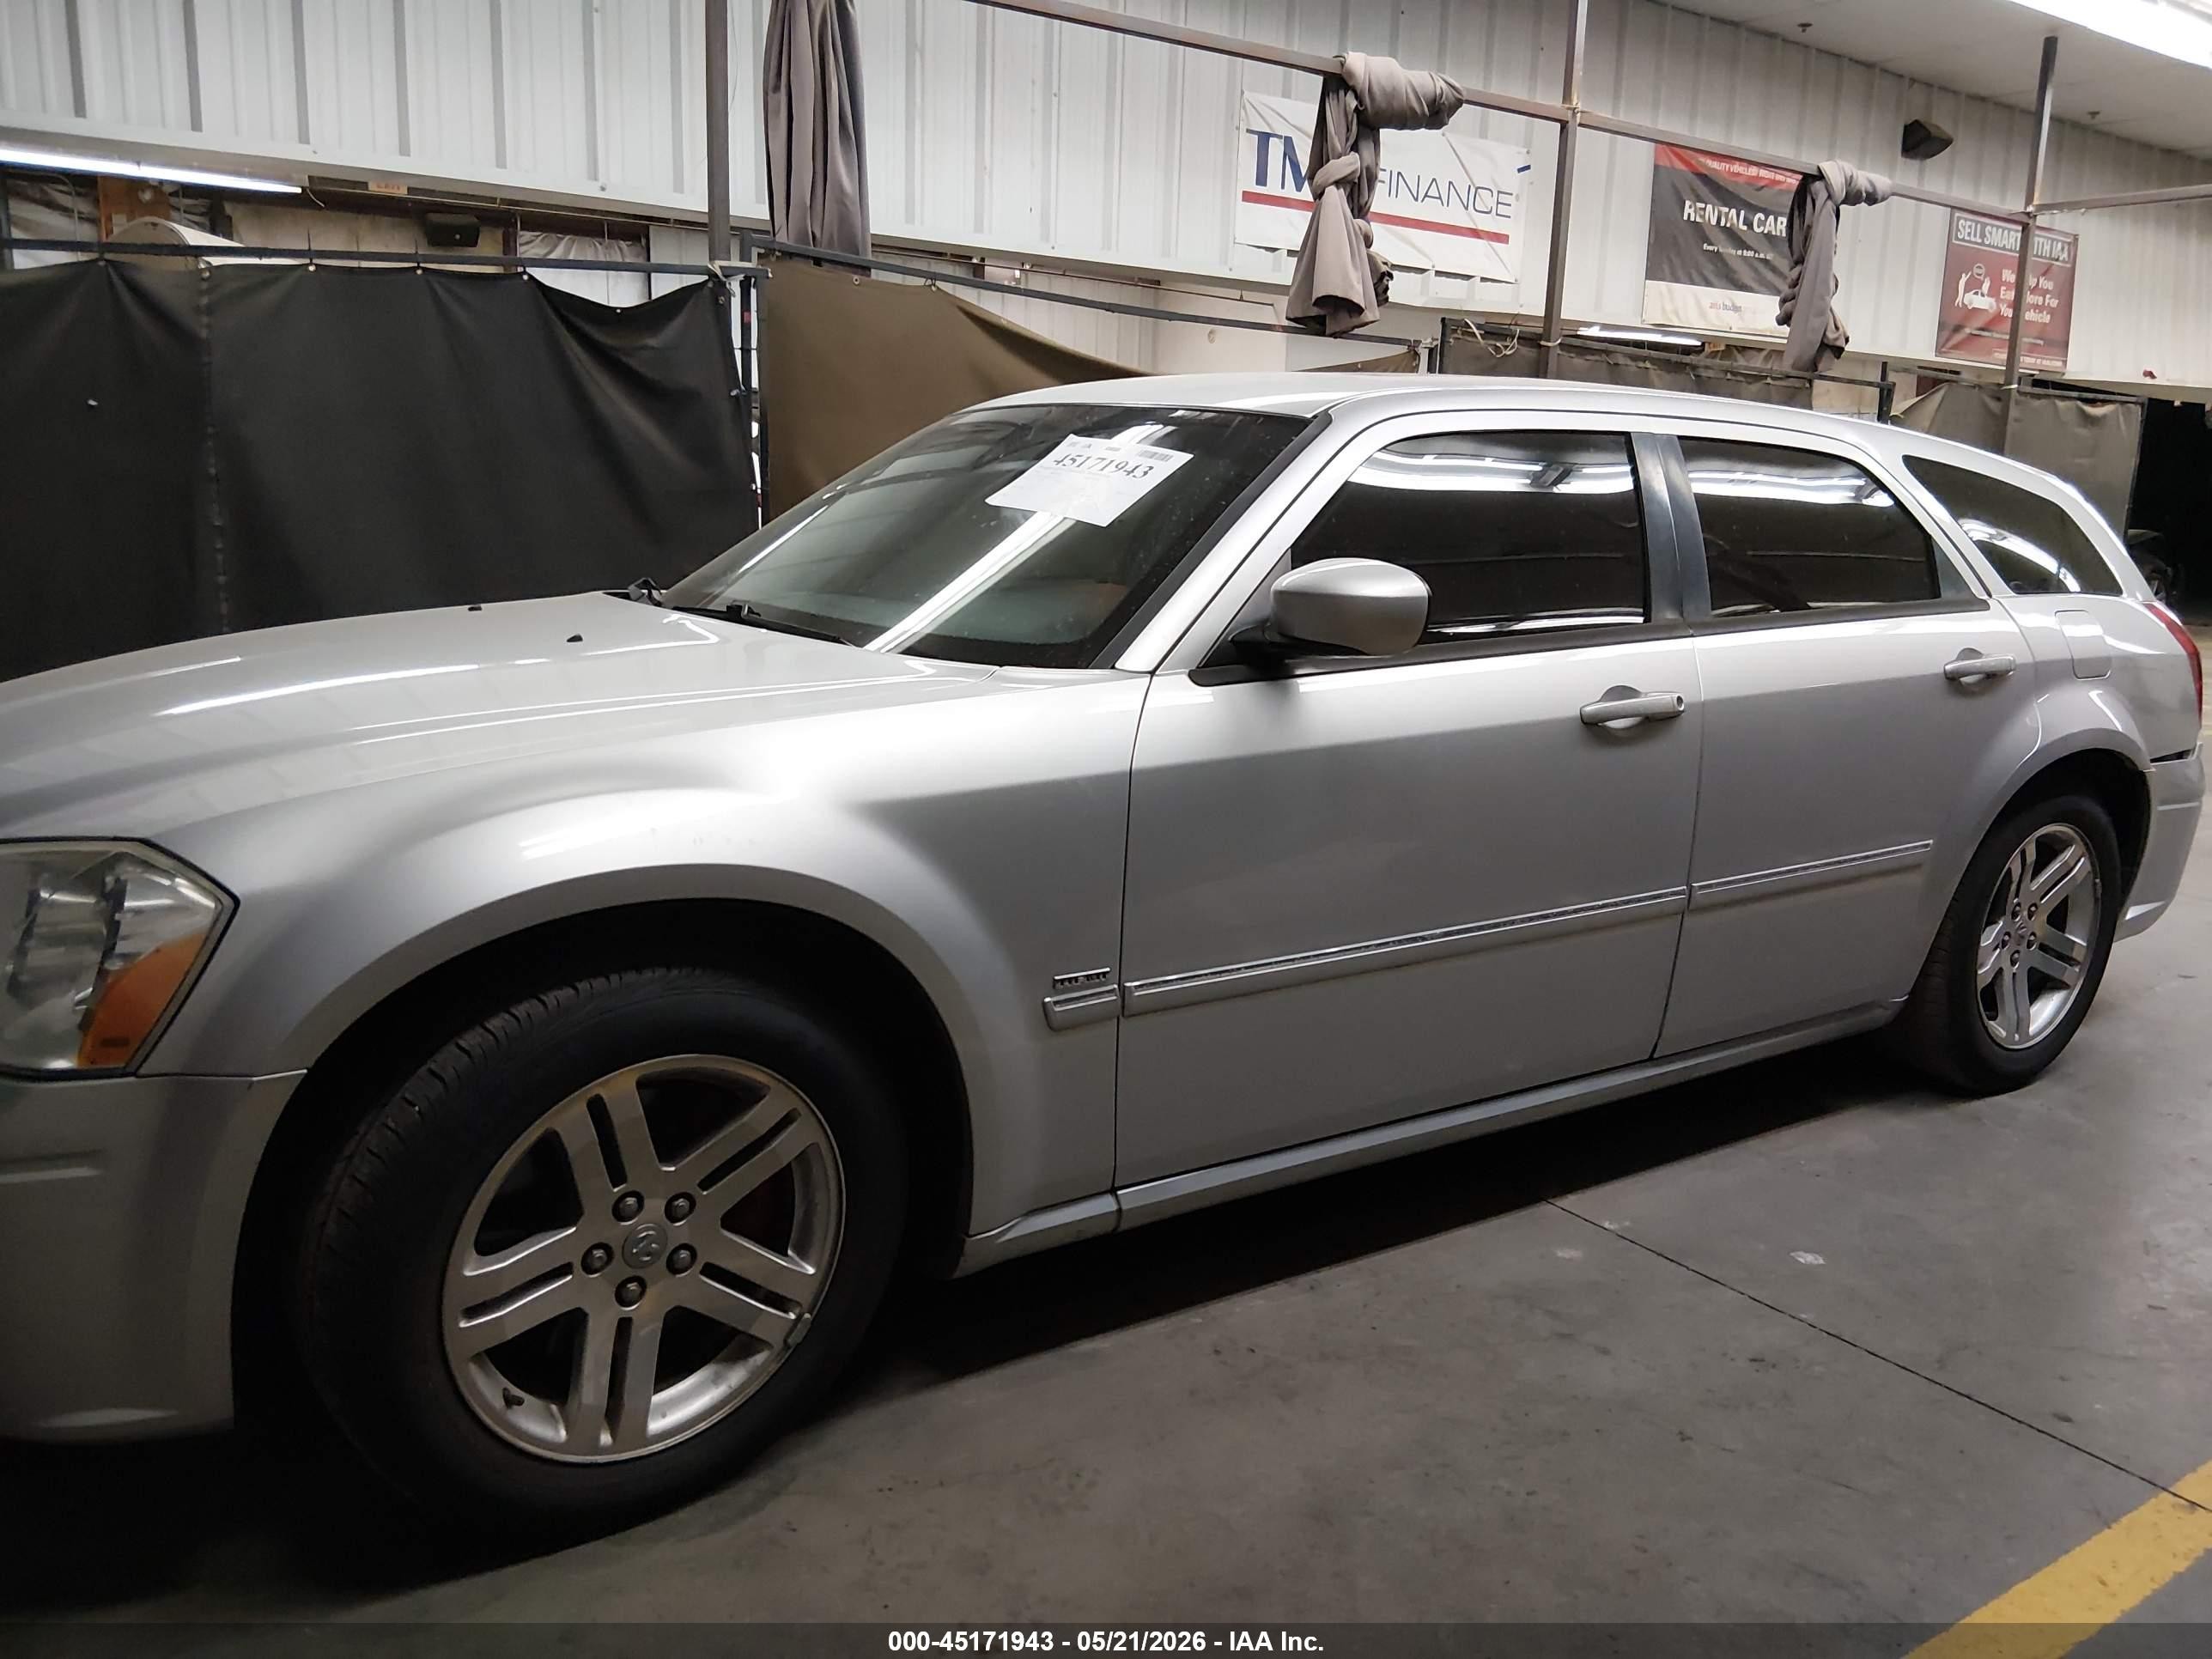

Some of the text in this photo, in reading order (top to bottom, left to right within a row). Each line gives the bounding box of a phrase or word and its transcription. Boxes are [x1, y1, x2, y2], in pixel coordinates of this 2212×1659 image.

[1683, 199, 1787, 237] RENTAL CAR
[1957, 219, 1982, 243] SELL
[1984, 225, 2021, 251] SMART
[2033, 235, 2051, 258] ITH
[2002, 268, 2016, 283] We
[2039, 276, 2054, 290] You
[1999, 303, 2051, 324] You ehicle
[1053, 453, 1155, 479] 45171943
